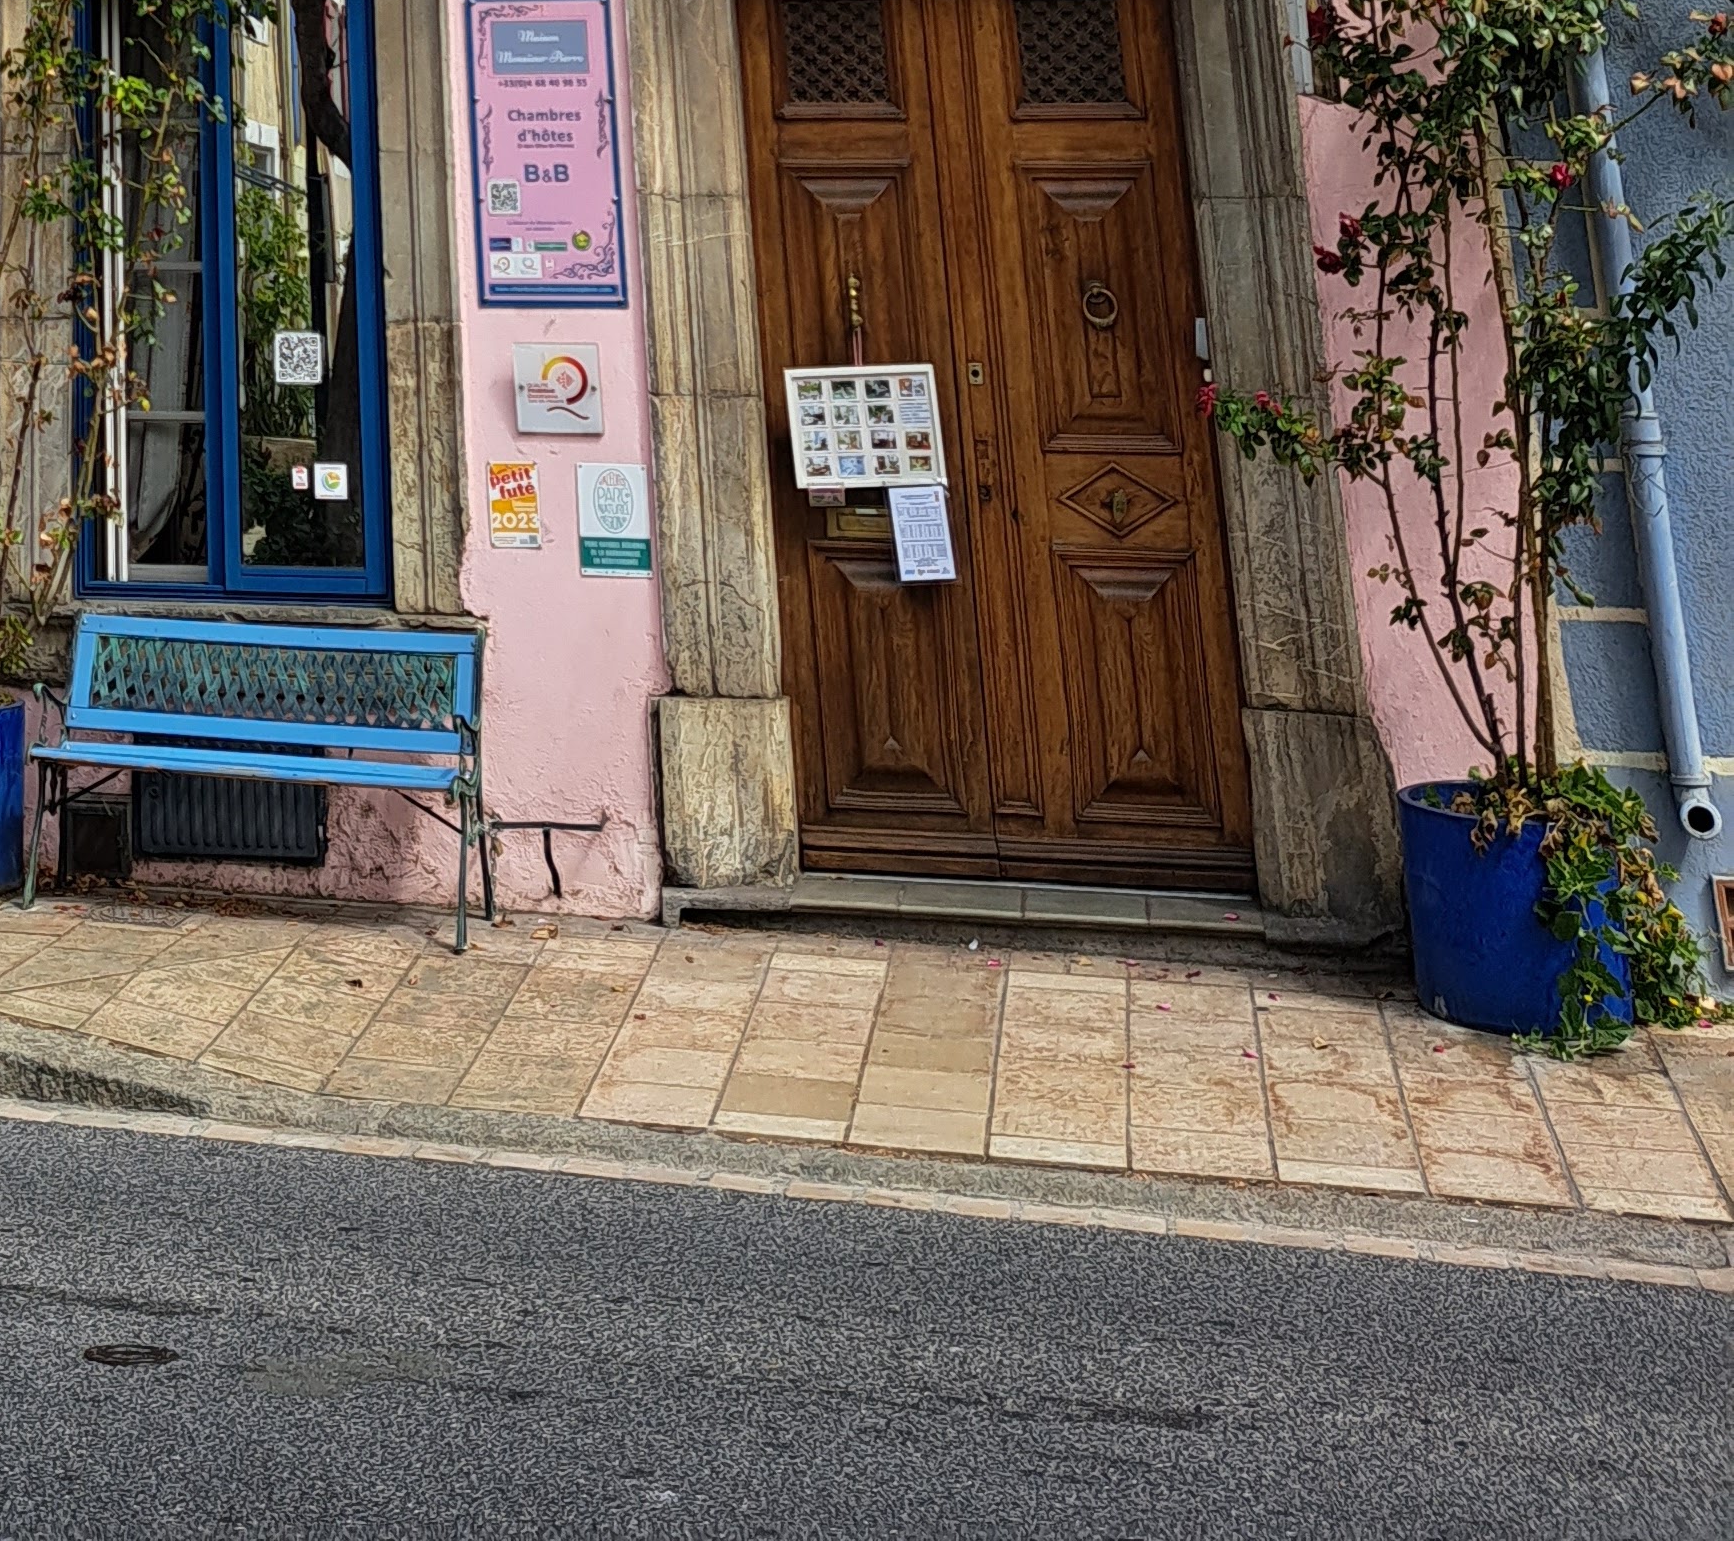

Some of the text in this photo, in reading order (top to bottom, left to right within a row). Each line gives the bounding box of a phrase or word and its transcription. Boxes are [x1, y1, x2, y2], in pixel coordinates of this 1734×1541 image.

[507, 108, 582, 122] Chambres
[517, 128, 574, 143] d'hôtes
[524, 164, 570, 184] B&B
[489, 467, 532, 490] petit
[499, 482, 536, 500] futé
[597, 486, 629, 504] PARC
[492, 512, 540, 529] 2023
